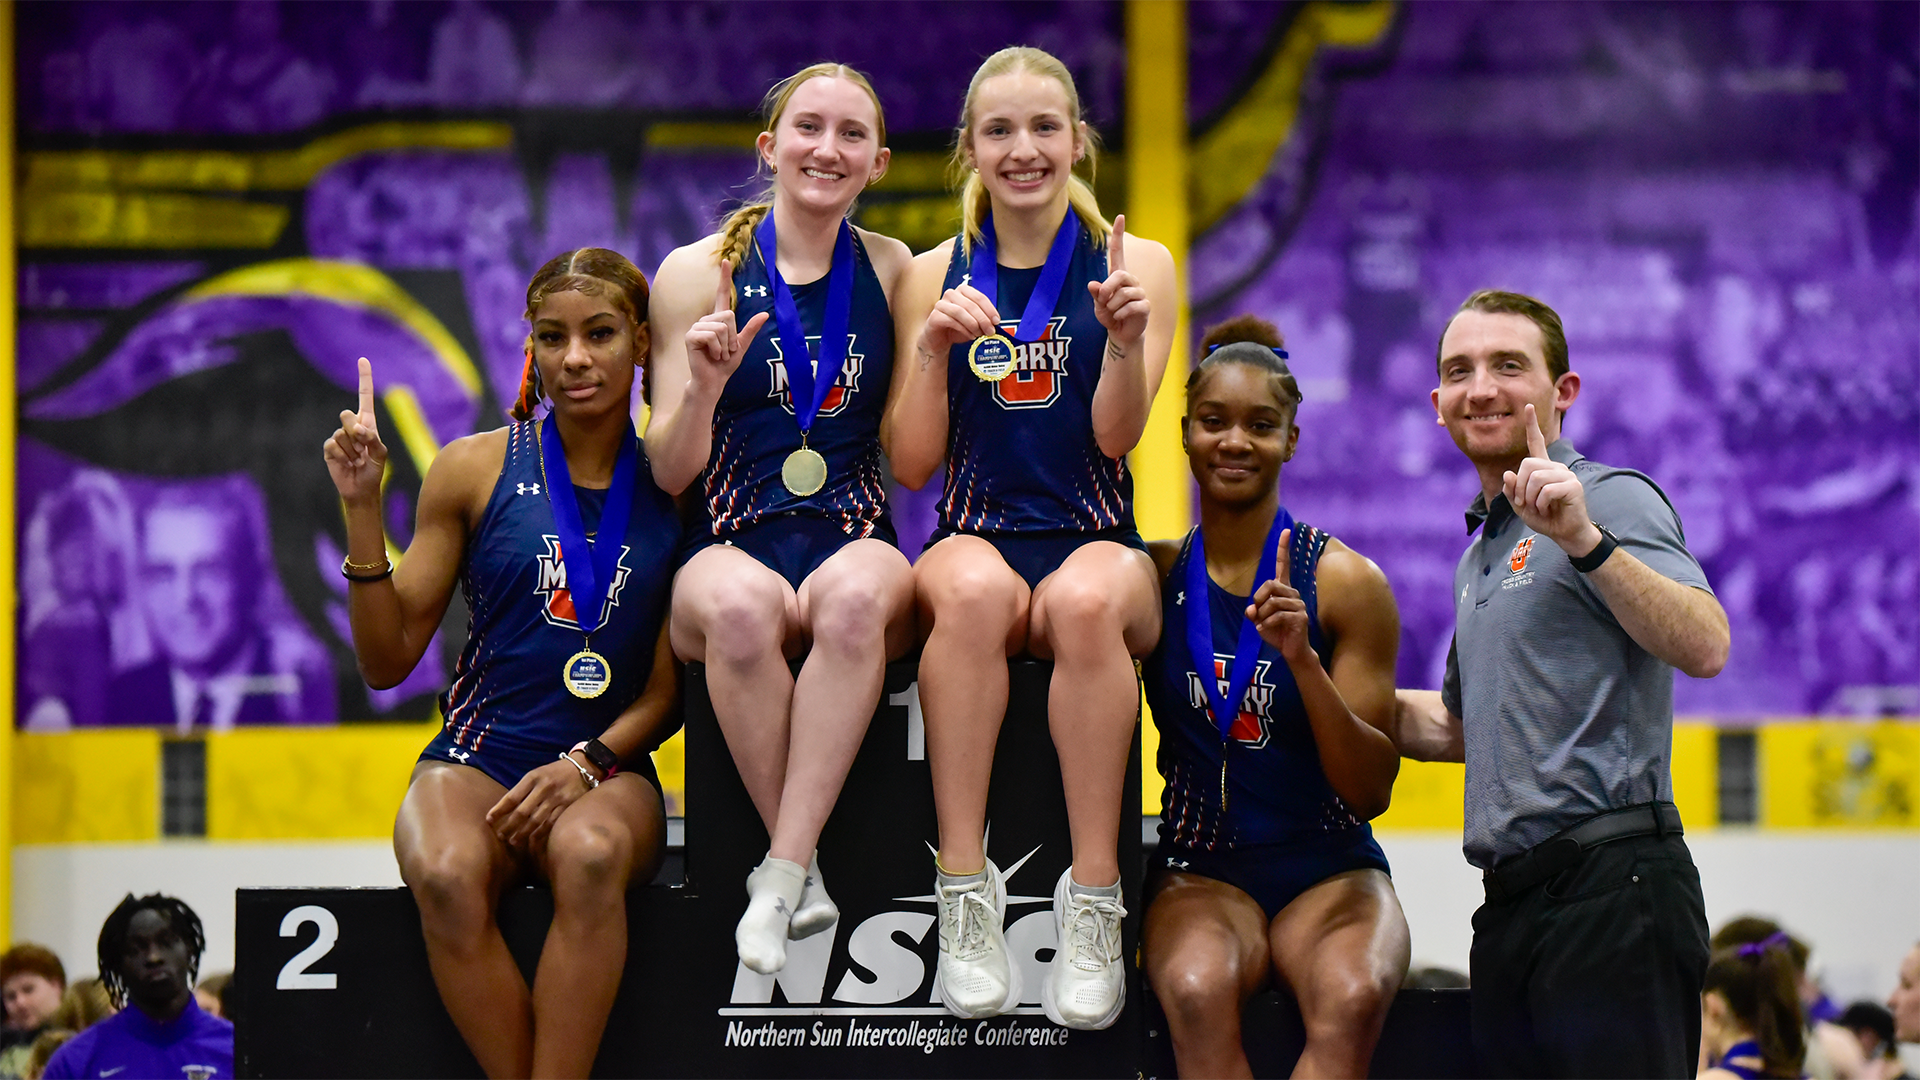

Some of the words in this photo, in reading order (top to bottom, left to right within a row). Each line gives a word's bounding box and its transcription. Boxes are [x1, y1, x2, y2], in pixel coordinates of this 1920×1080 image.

[1013, 341, 1065, 371] ARY
[541, 558, 625, 600] MY
[889, 681, 925, 760] 1
[276, 905, 339, 990] 2
[725, 1021, 806, 1047] Northern
[810, 1020, 843, 1047] Sun
[846, 1018, 968, 1054] Intercollegiate
[974, 1020, 1069, 1047] Conference
